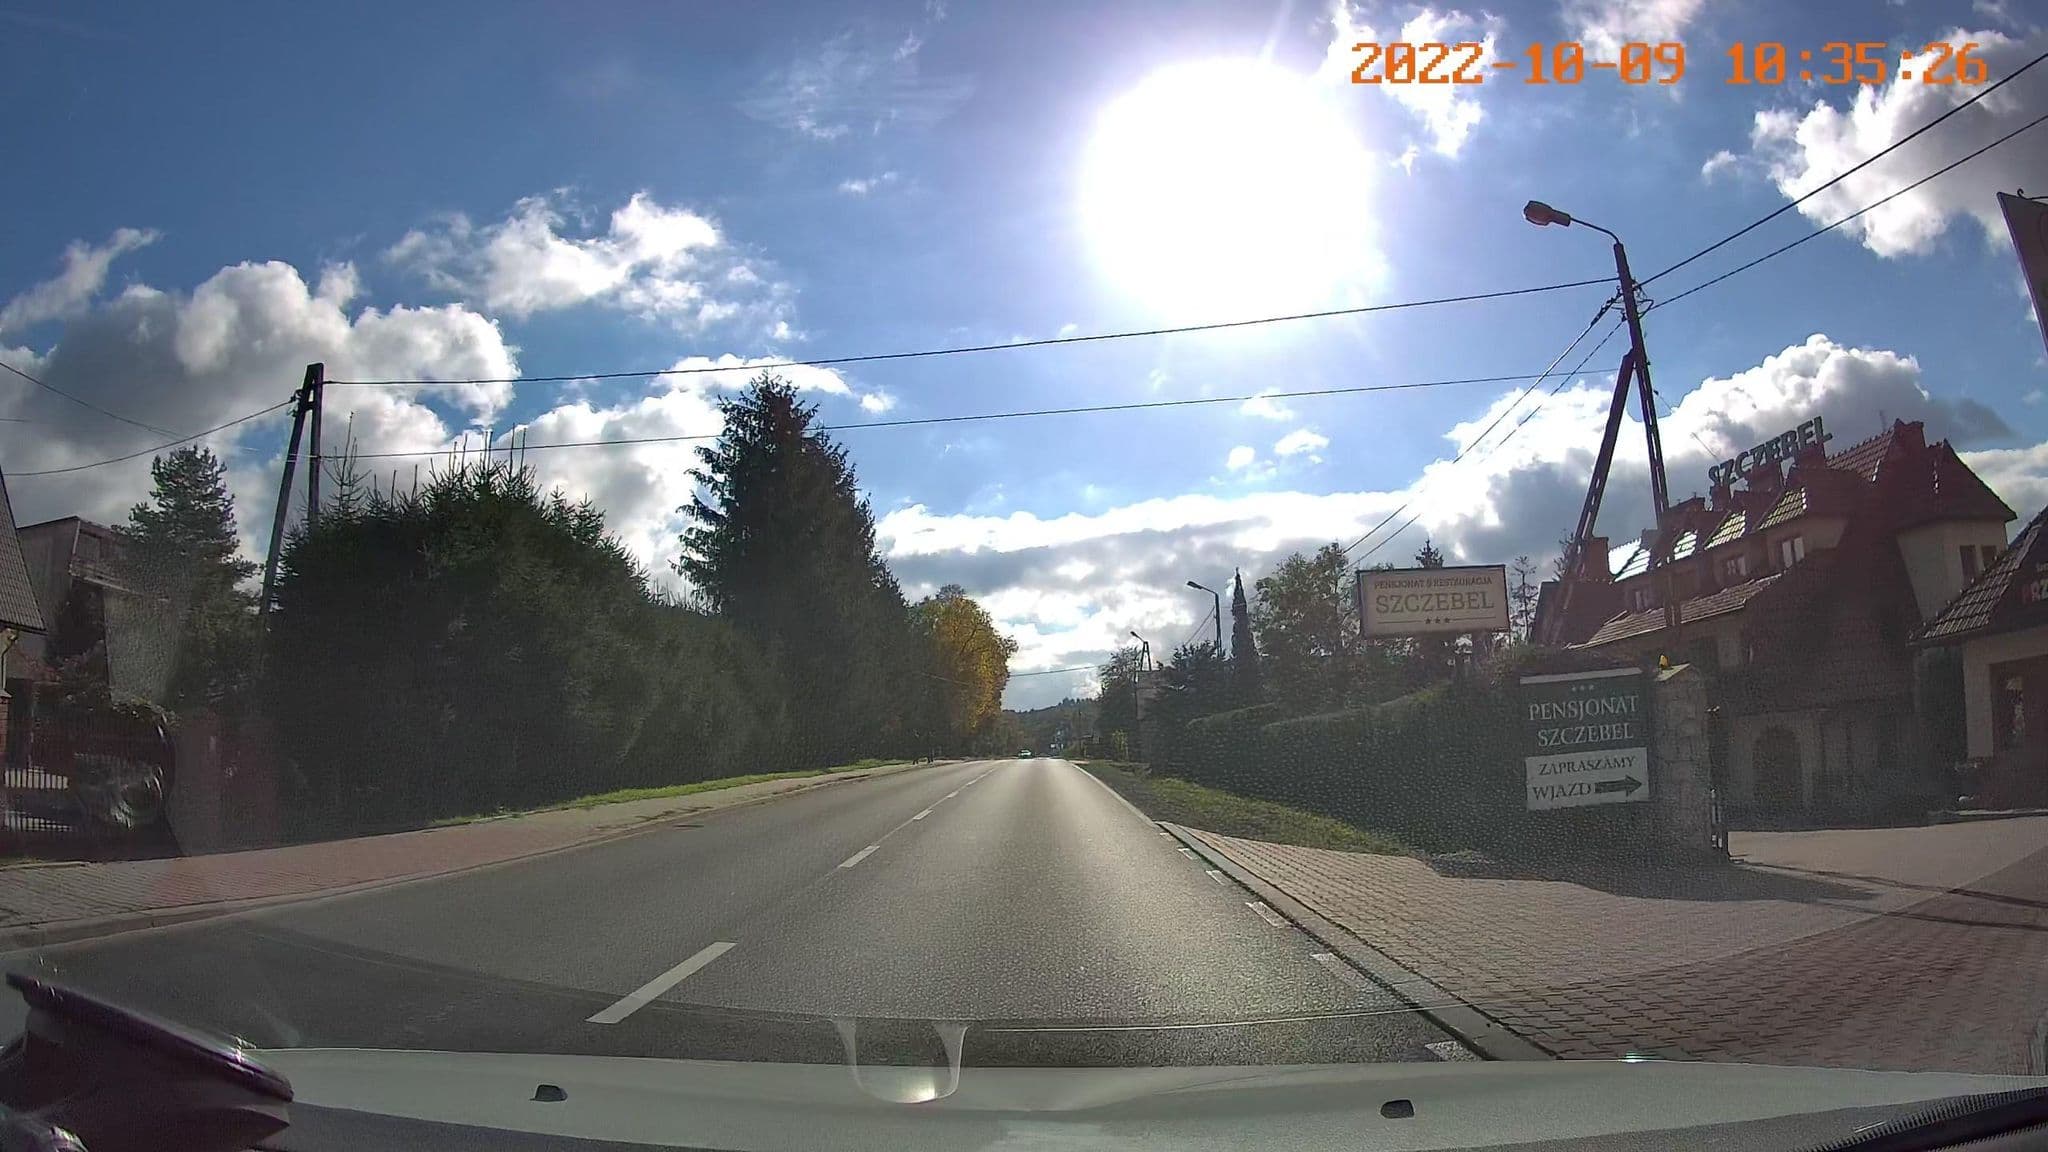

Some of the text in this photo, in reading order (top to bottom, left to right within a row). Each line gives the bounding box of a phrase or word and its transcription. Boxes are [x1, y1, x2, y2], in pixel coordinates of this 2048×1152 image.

[1708, 415, 1833, 487] SZCZEBEL
[1375, 591, 1494, 614] SZCZEBEL
[1528, 695, 1639, 721] PENSJONAT
[1537, 722, 1634, 747] SZCZEBEL
[1538, 755, 1635, 776] ZAPRASZAMY
[1532, 782, 1592, 800] WJAZD
